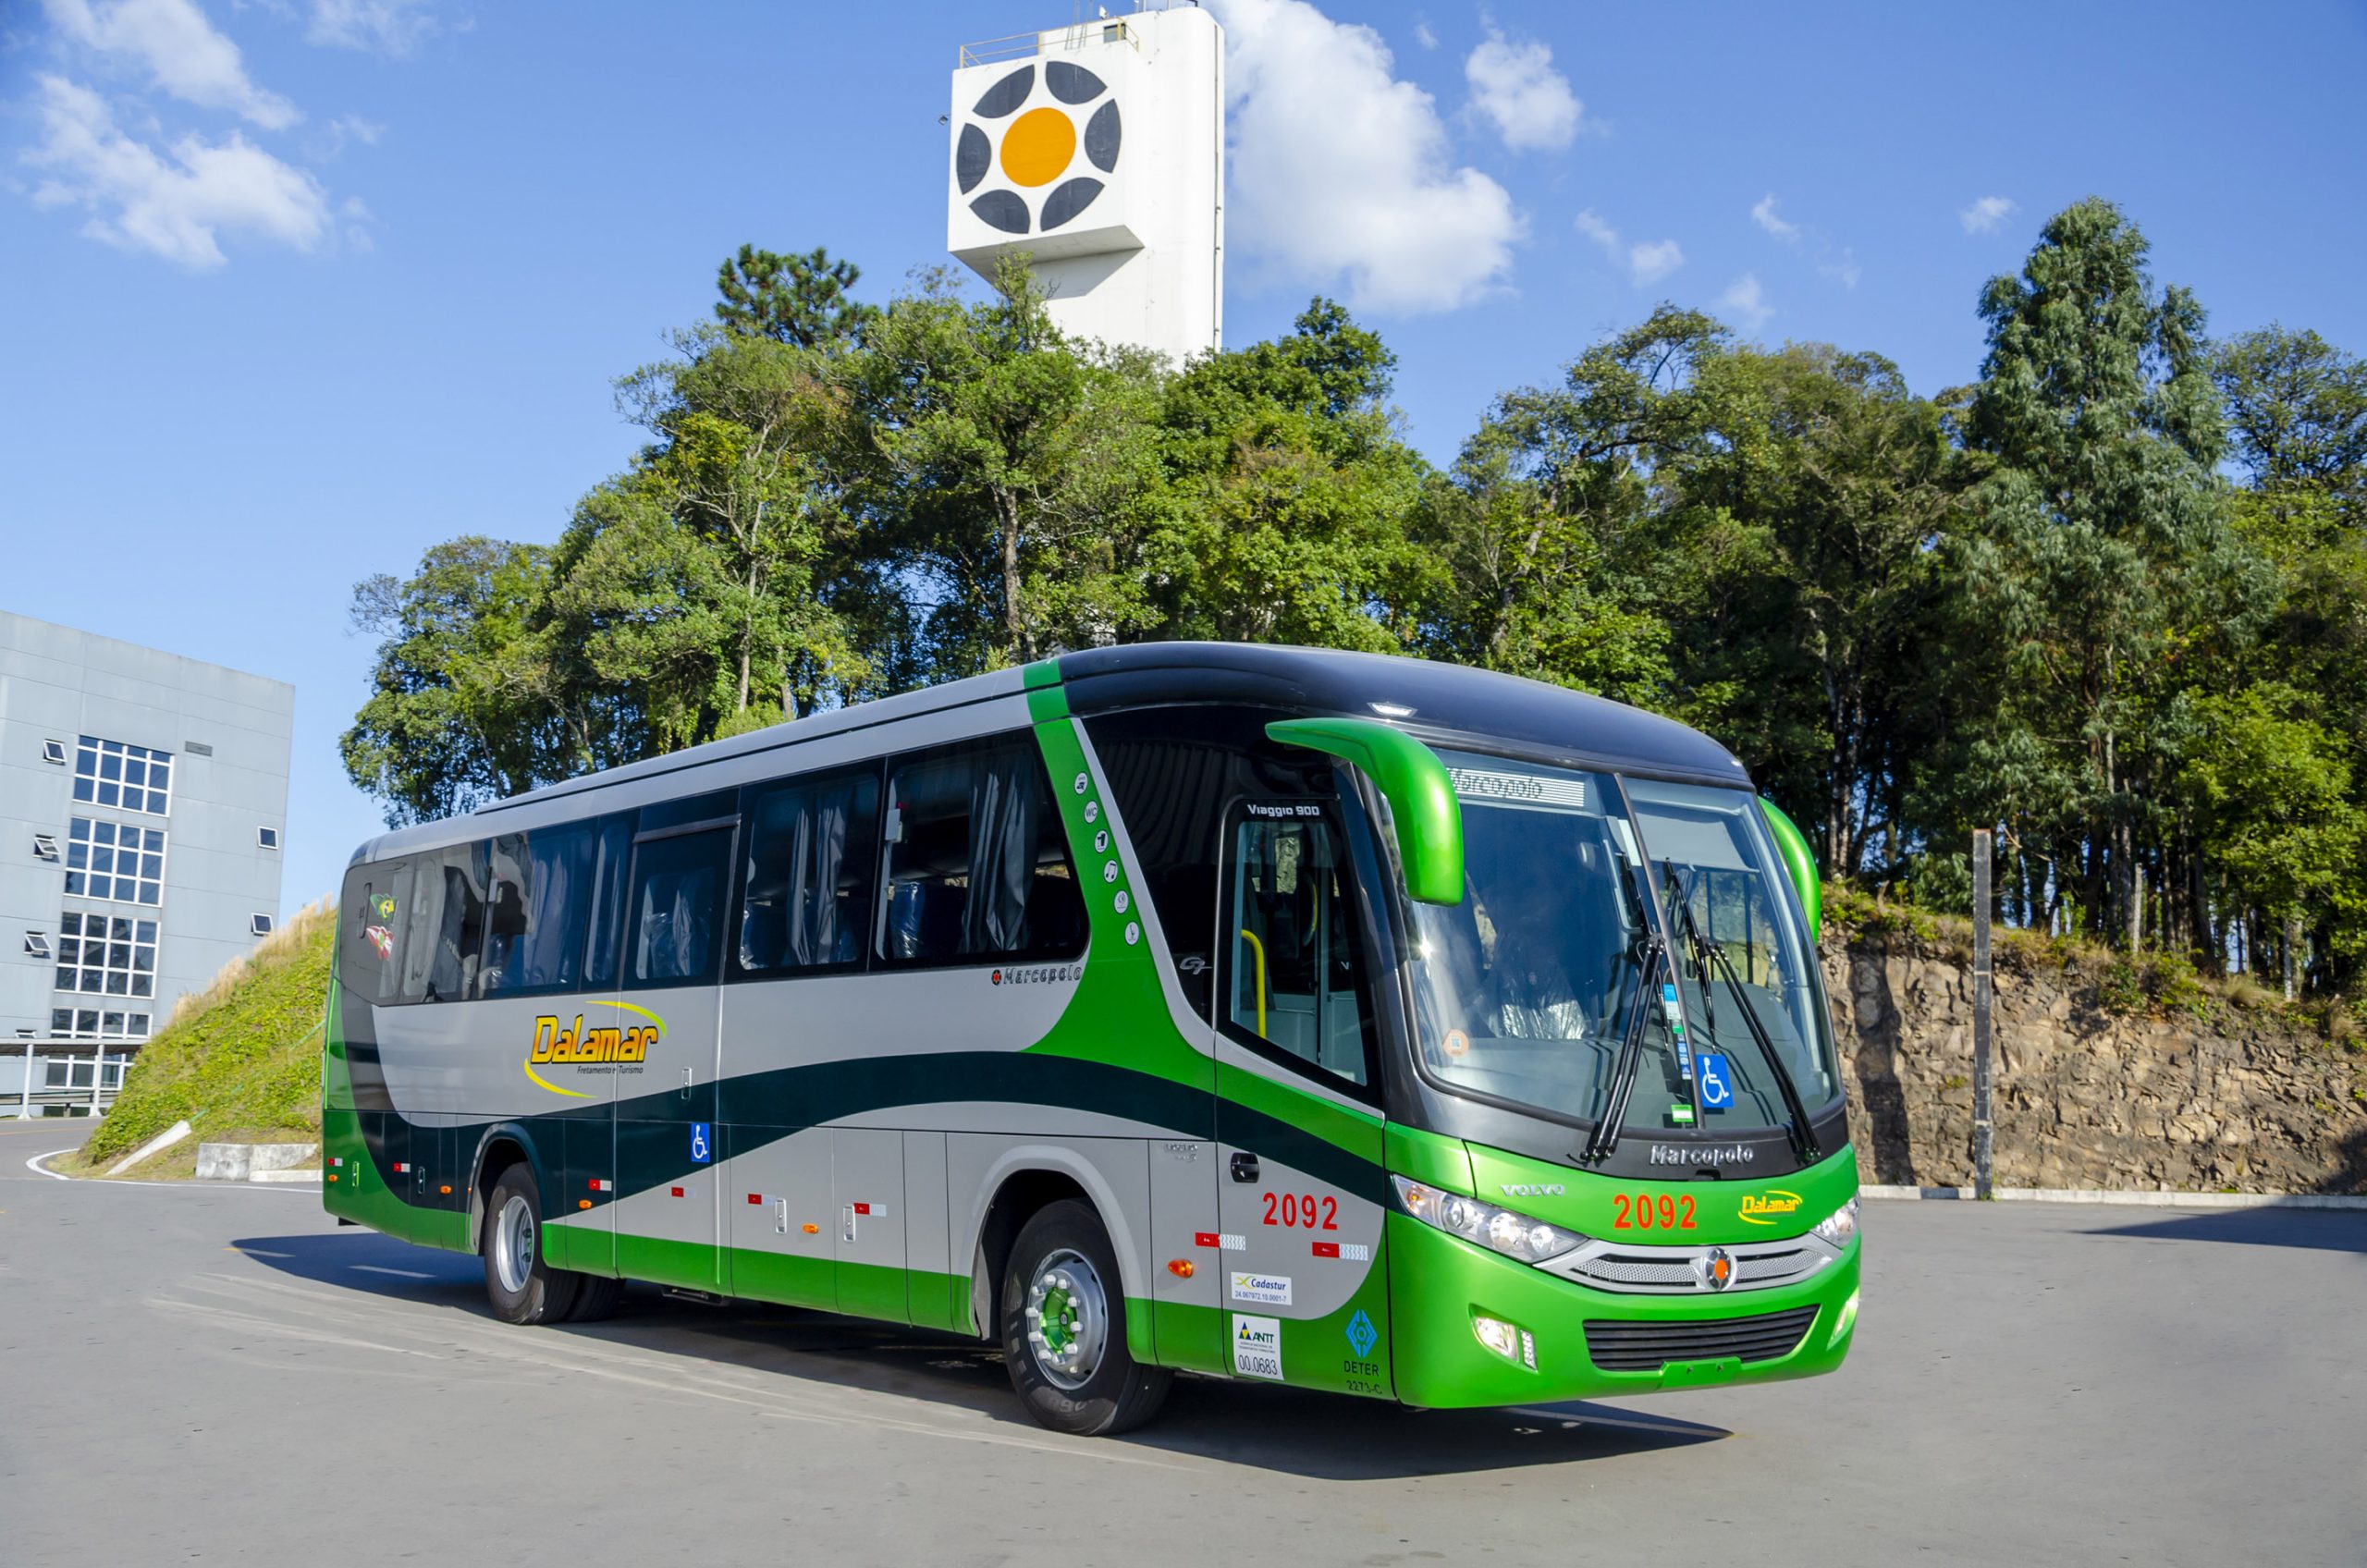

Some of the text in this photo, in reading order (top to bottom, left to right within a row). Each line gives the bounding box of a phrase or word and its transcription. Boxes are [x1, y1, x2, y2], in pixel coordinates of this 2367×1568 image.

[1085, 806, 1097, 818] WC
[1247, 804, 1320, 817] Viaggio 900
[1003, 964, 1082, 985] Marcopolo
[577, 1065, 611, 1074] Fretamento
[619, 1065, 644, 1074] Turismo
[1650, 1145, 1754, 1167] Marcopolo
[1500, 1184, 1566, 1197] VOLVO
[1263, 1193, 1338, 1231] 2092
[1613, 1194, 1697, 1230] 2092
[1251, 1278, 1286, 1291] Cadastur
[1253, 1332, 1274, 1343] ANTT
[1238, 1354, 1278, 1376] 00.0683
[1343, 1360, 1379, 1377] DETER
